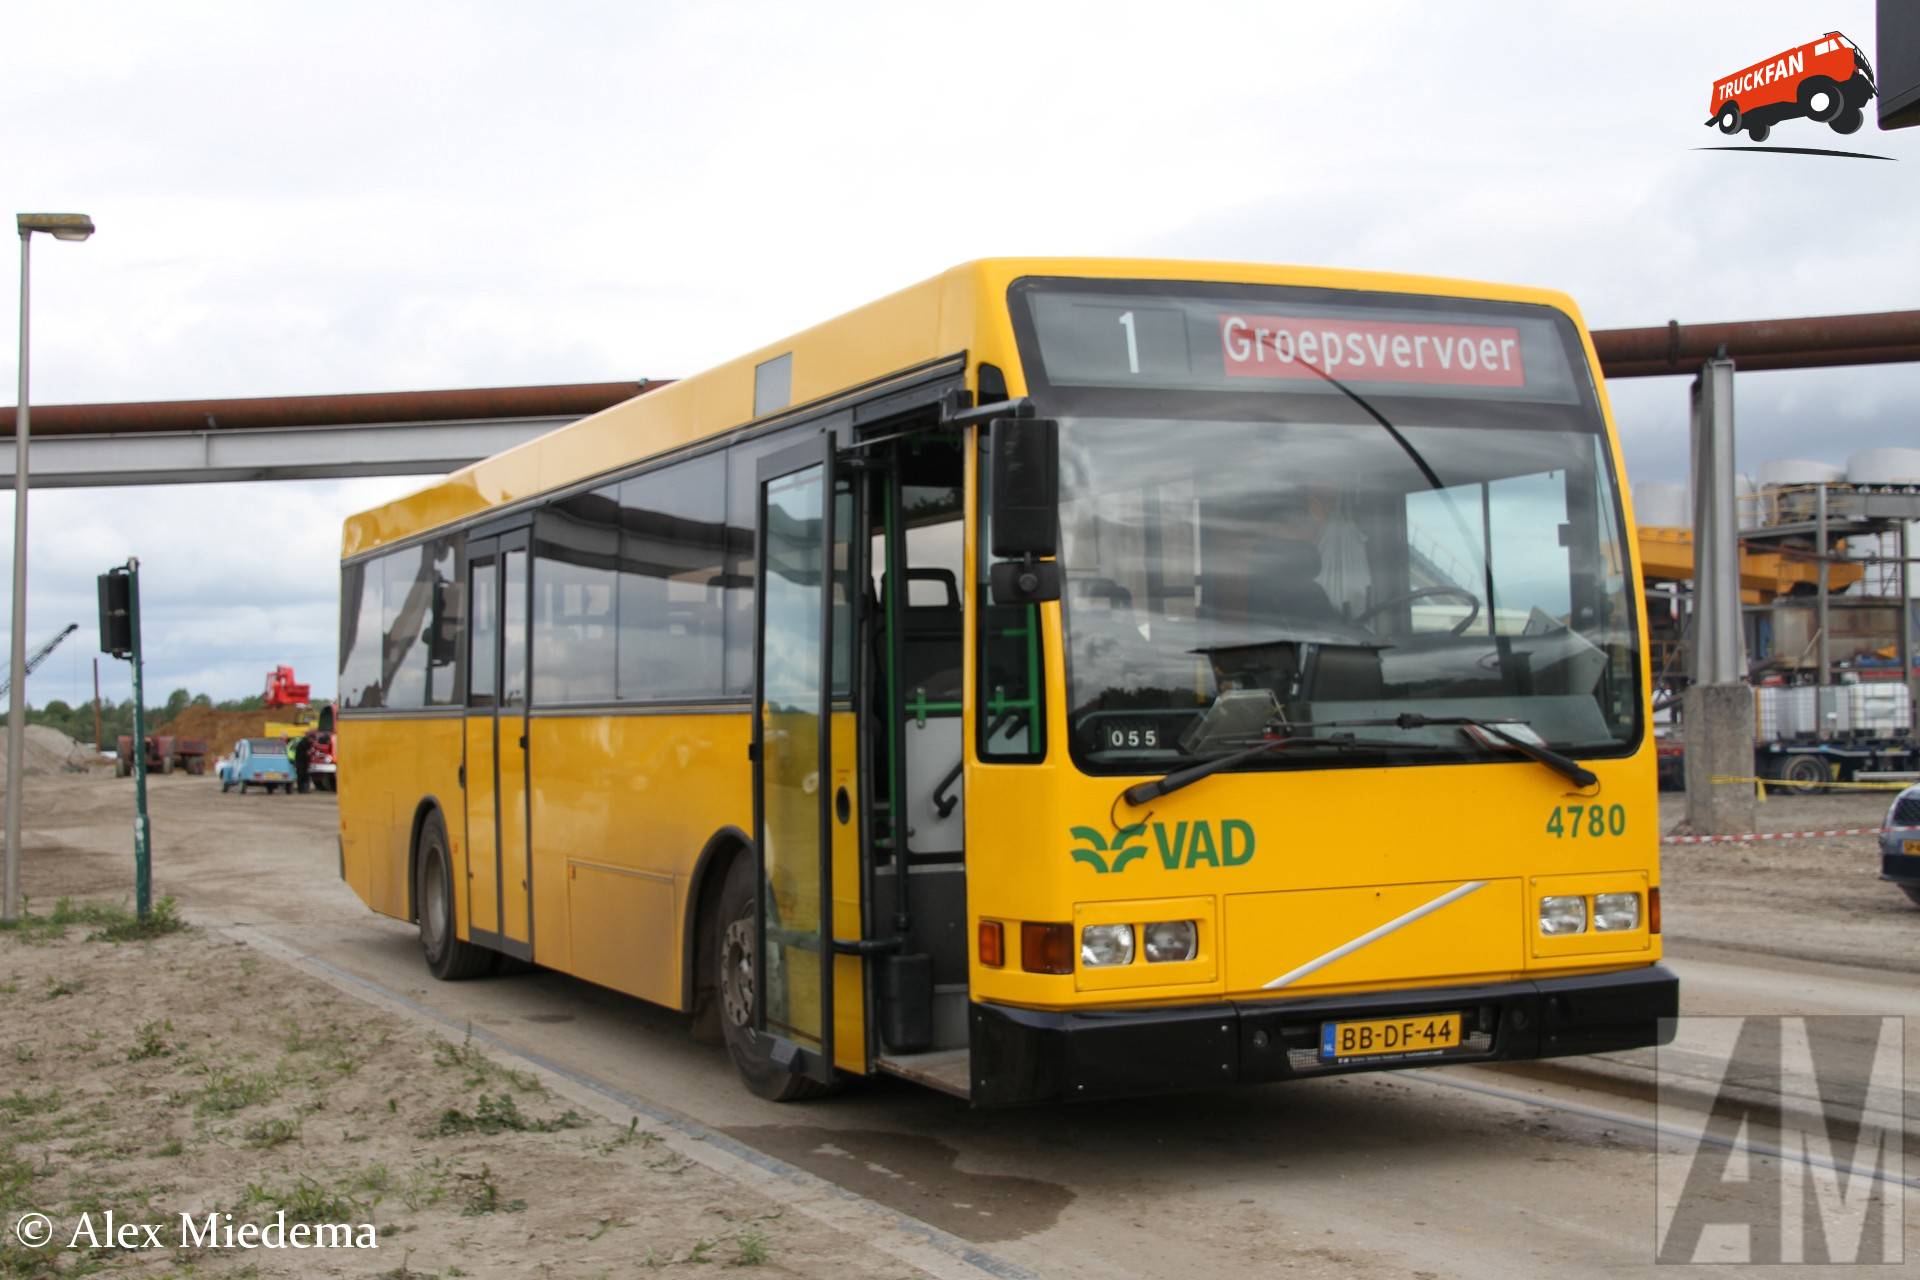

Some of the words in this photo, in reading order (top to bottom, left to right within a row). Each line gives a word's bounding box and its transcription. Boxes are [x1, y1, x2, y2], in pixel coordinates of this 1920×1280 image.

[1119, 311, 1140, 374] 1
[1223, 316, 1516, 375] Groepsvervoer
[1111, 730, 1157, 747] 055
[1546, 804, 1626, 838] 4780
[1152, 819, 1256, 870] VAD
[1342, 1020, 1453, 1051] BB-DF-44
